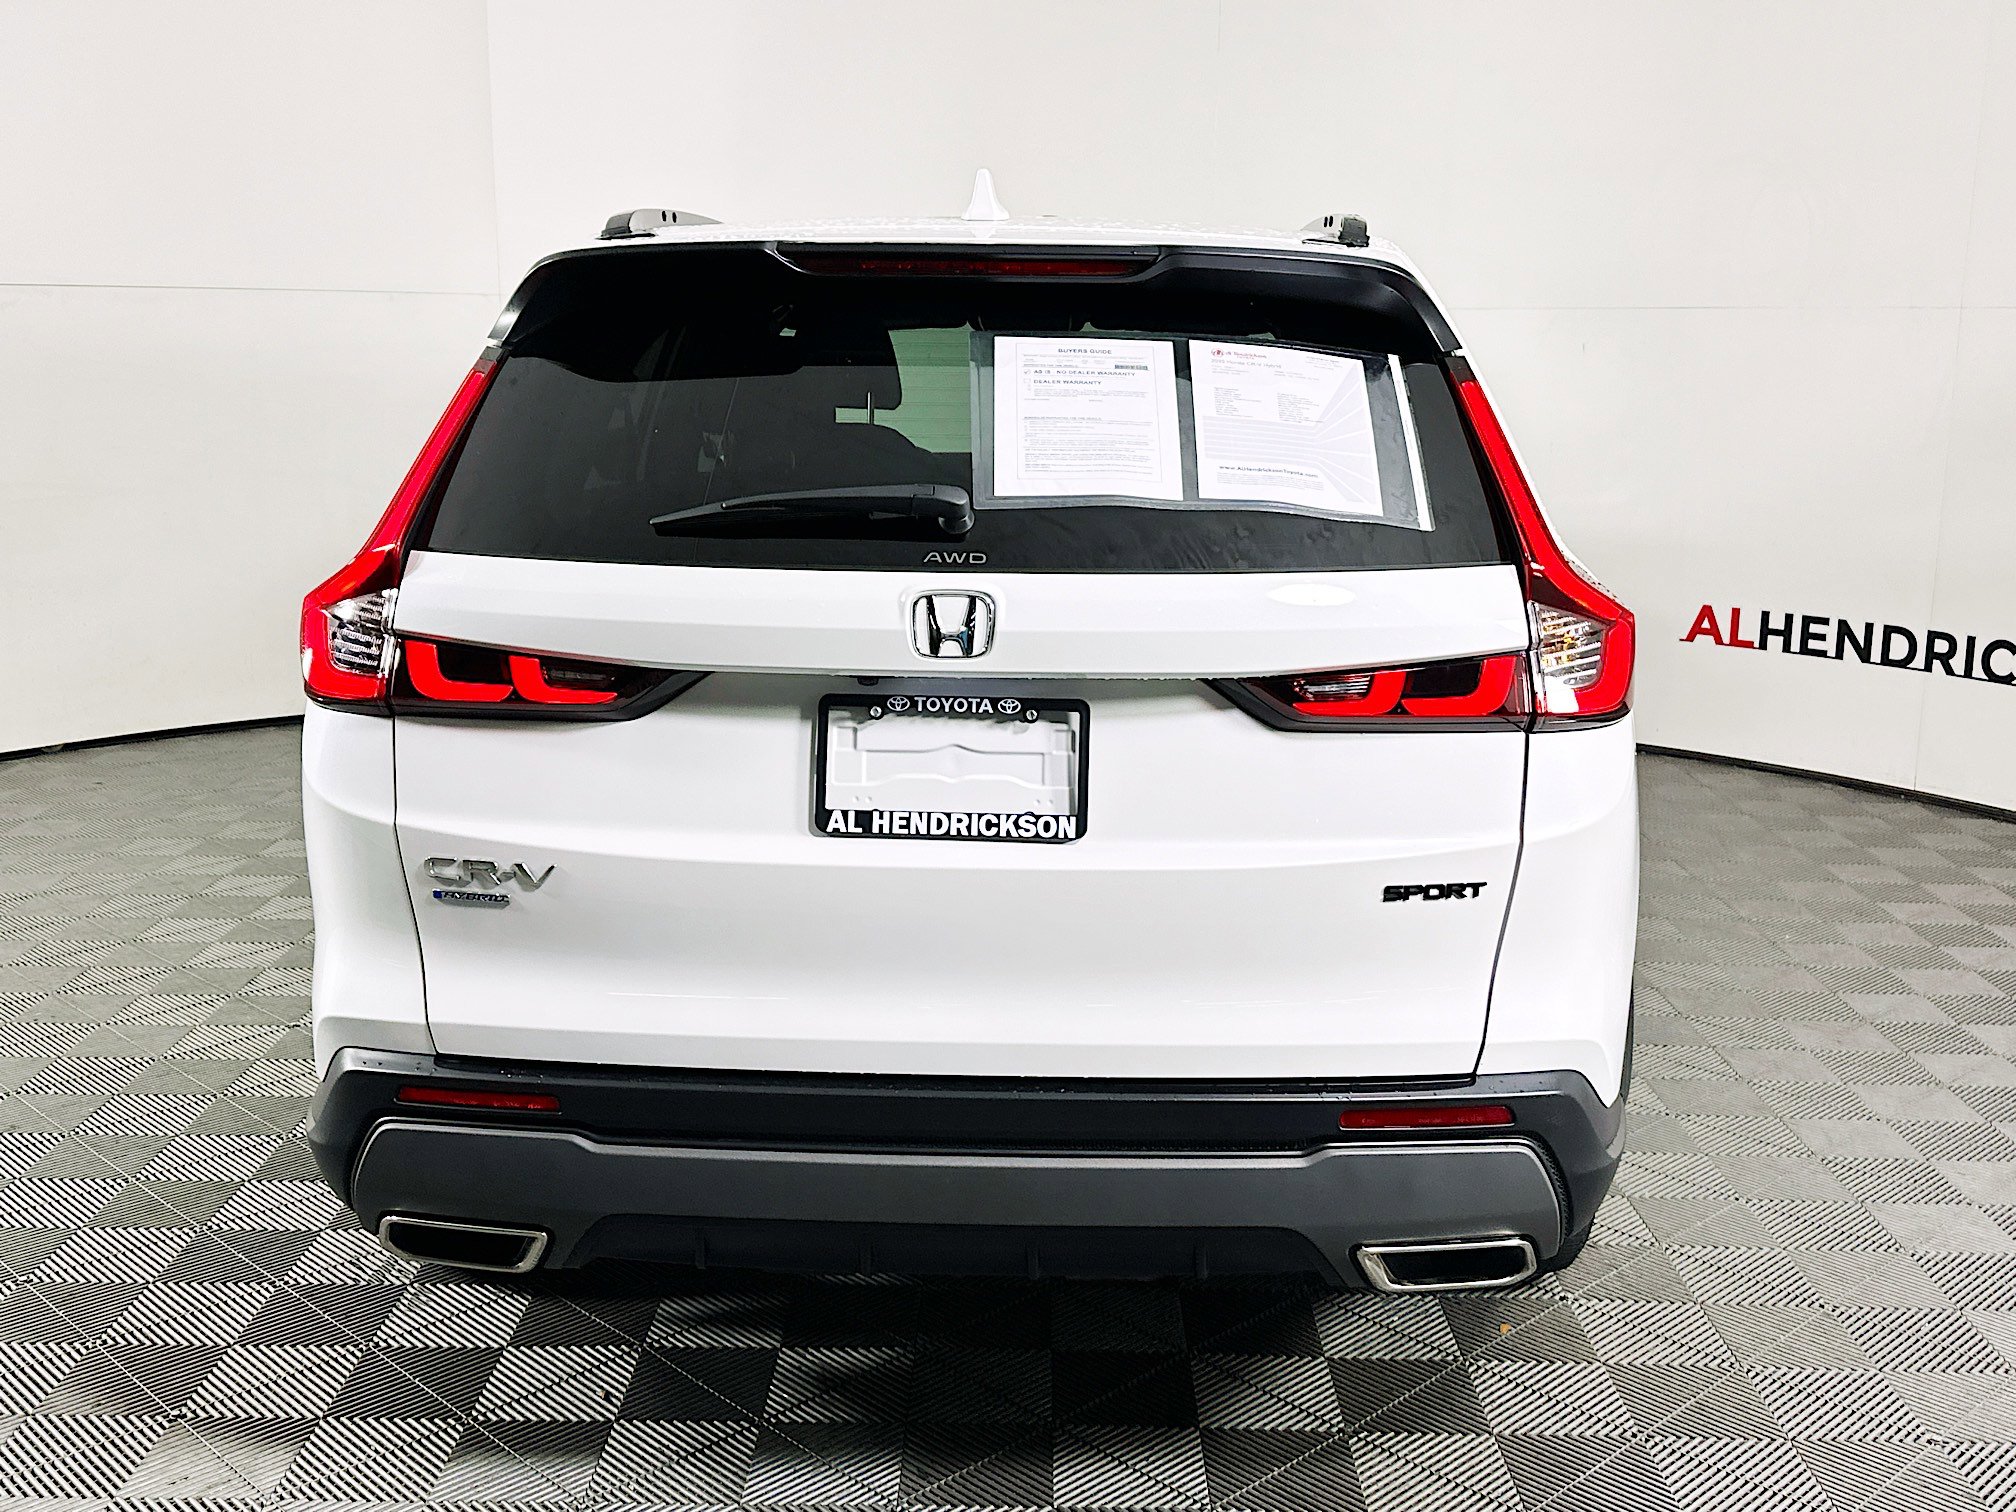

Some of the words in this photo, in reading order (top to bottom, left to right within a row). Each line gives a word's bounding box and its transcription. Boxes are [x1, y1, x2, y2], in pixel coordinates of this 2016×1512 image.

[923, 552, 987, 564] AWD
[914, 697, 994, 714] TOYOTA
[826, 810, 863, 833] AL
[872, 811, 1077, 839] HENDRICKSON
[1382, 882, 1487, 902] SPORT
